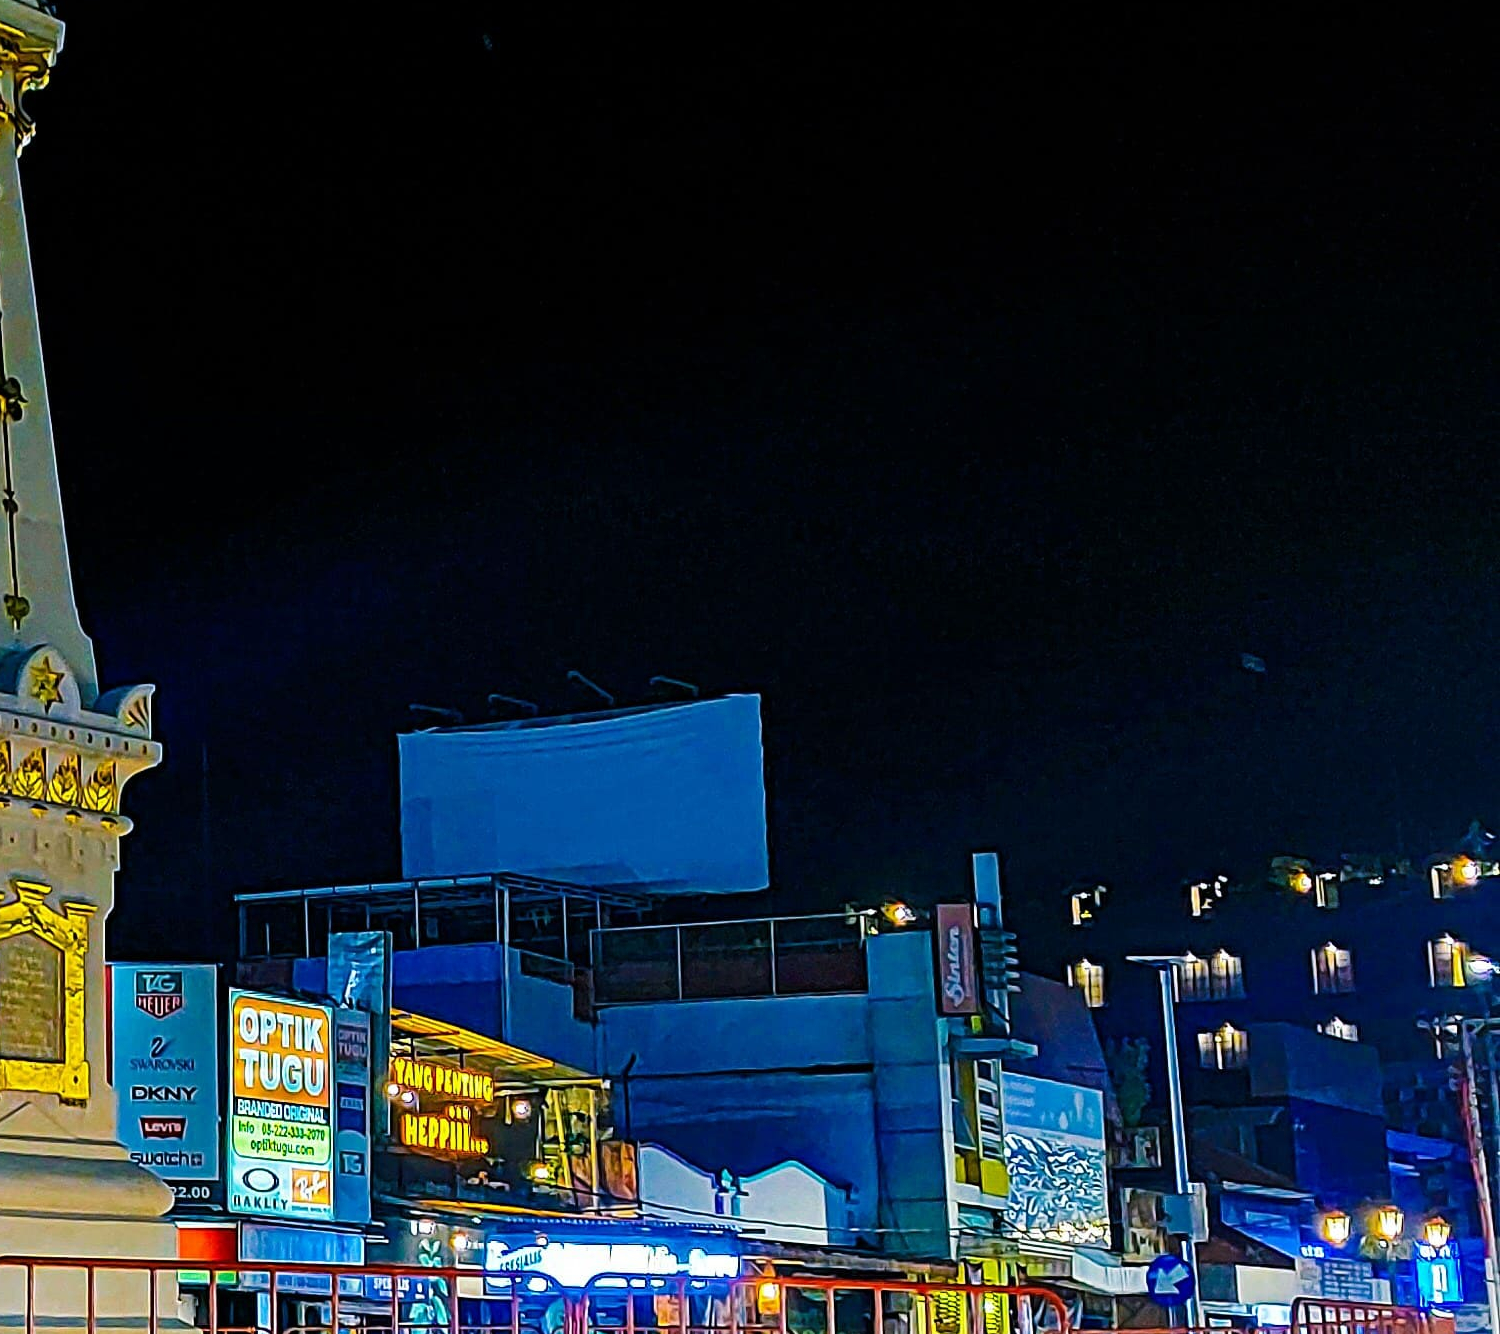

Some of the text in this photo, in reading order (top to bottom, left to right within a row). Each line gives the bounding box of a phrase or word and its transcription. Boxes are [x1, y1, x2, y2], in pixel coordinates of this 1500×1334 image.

[142, 974, 176, 992] TAG
[138, 996, 181, 1016] HEUER
[239, 1006, 324, 1053] OPTIK
[238, 1048, 325, 1097] TUGU
[394, 1057, 494, 1103] YANG PENTING
[131, 1086, 197, 1101] DKNY
[237, 1098, 327, 1124] BRANDED ORIGINAL
[238, 1120, 255, 1134] Info
[250, 1138, 315, 1156] optiktugu.com
